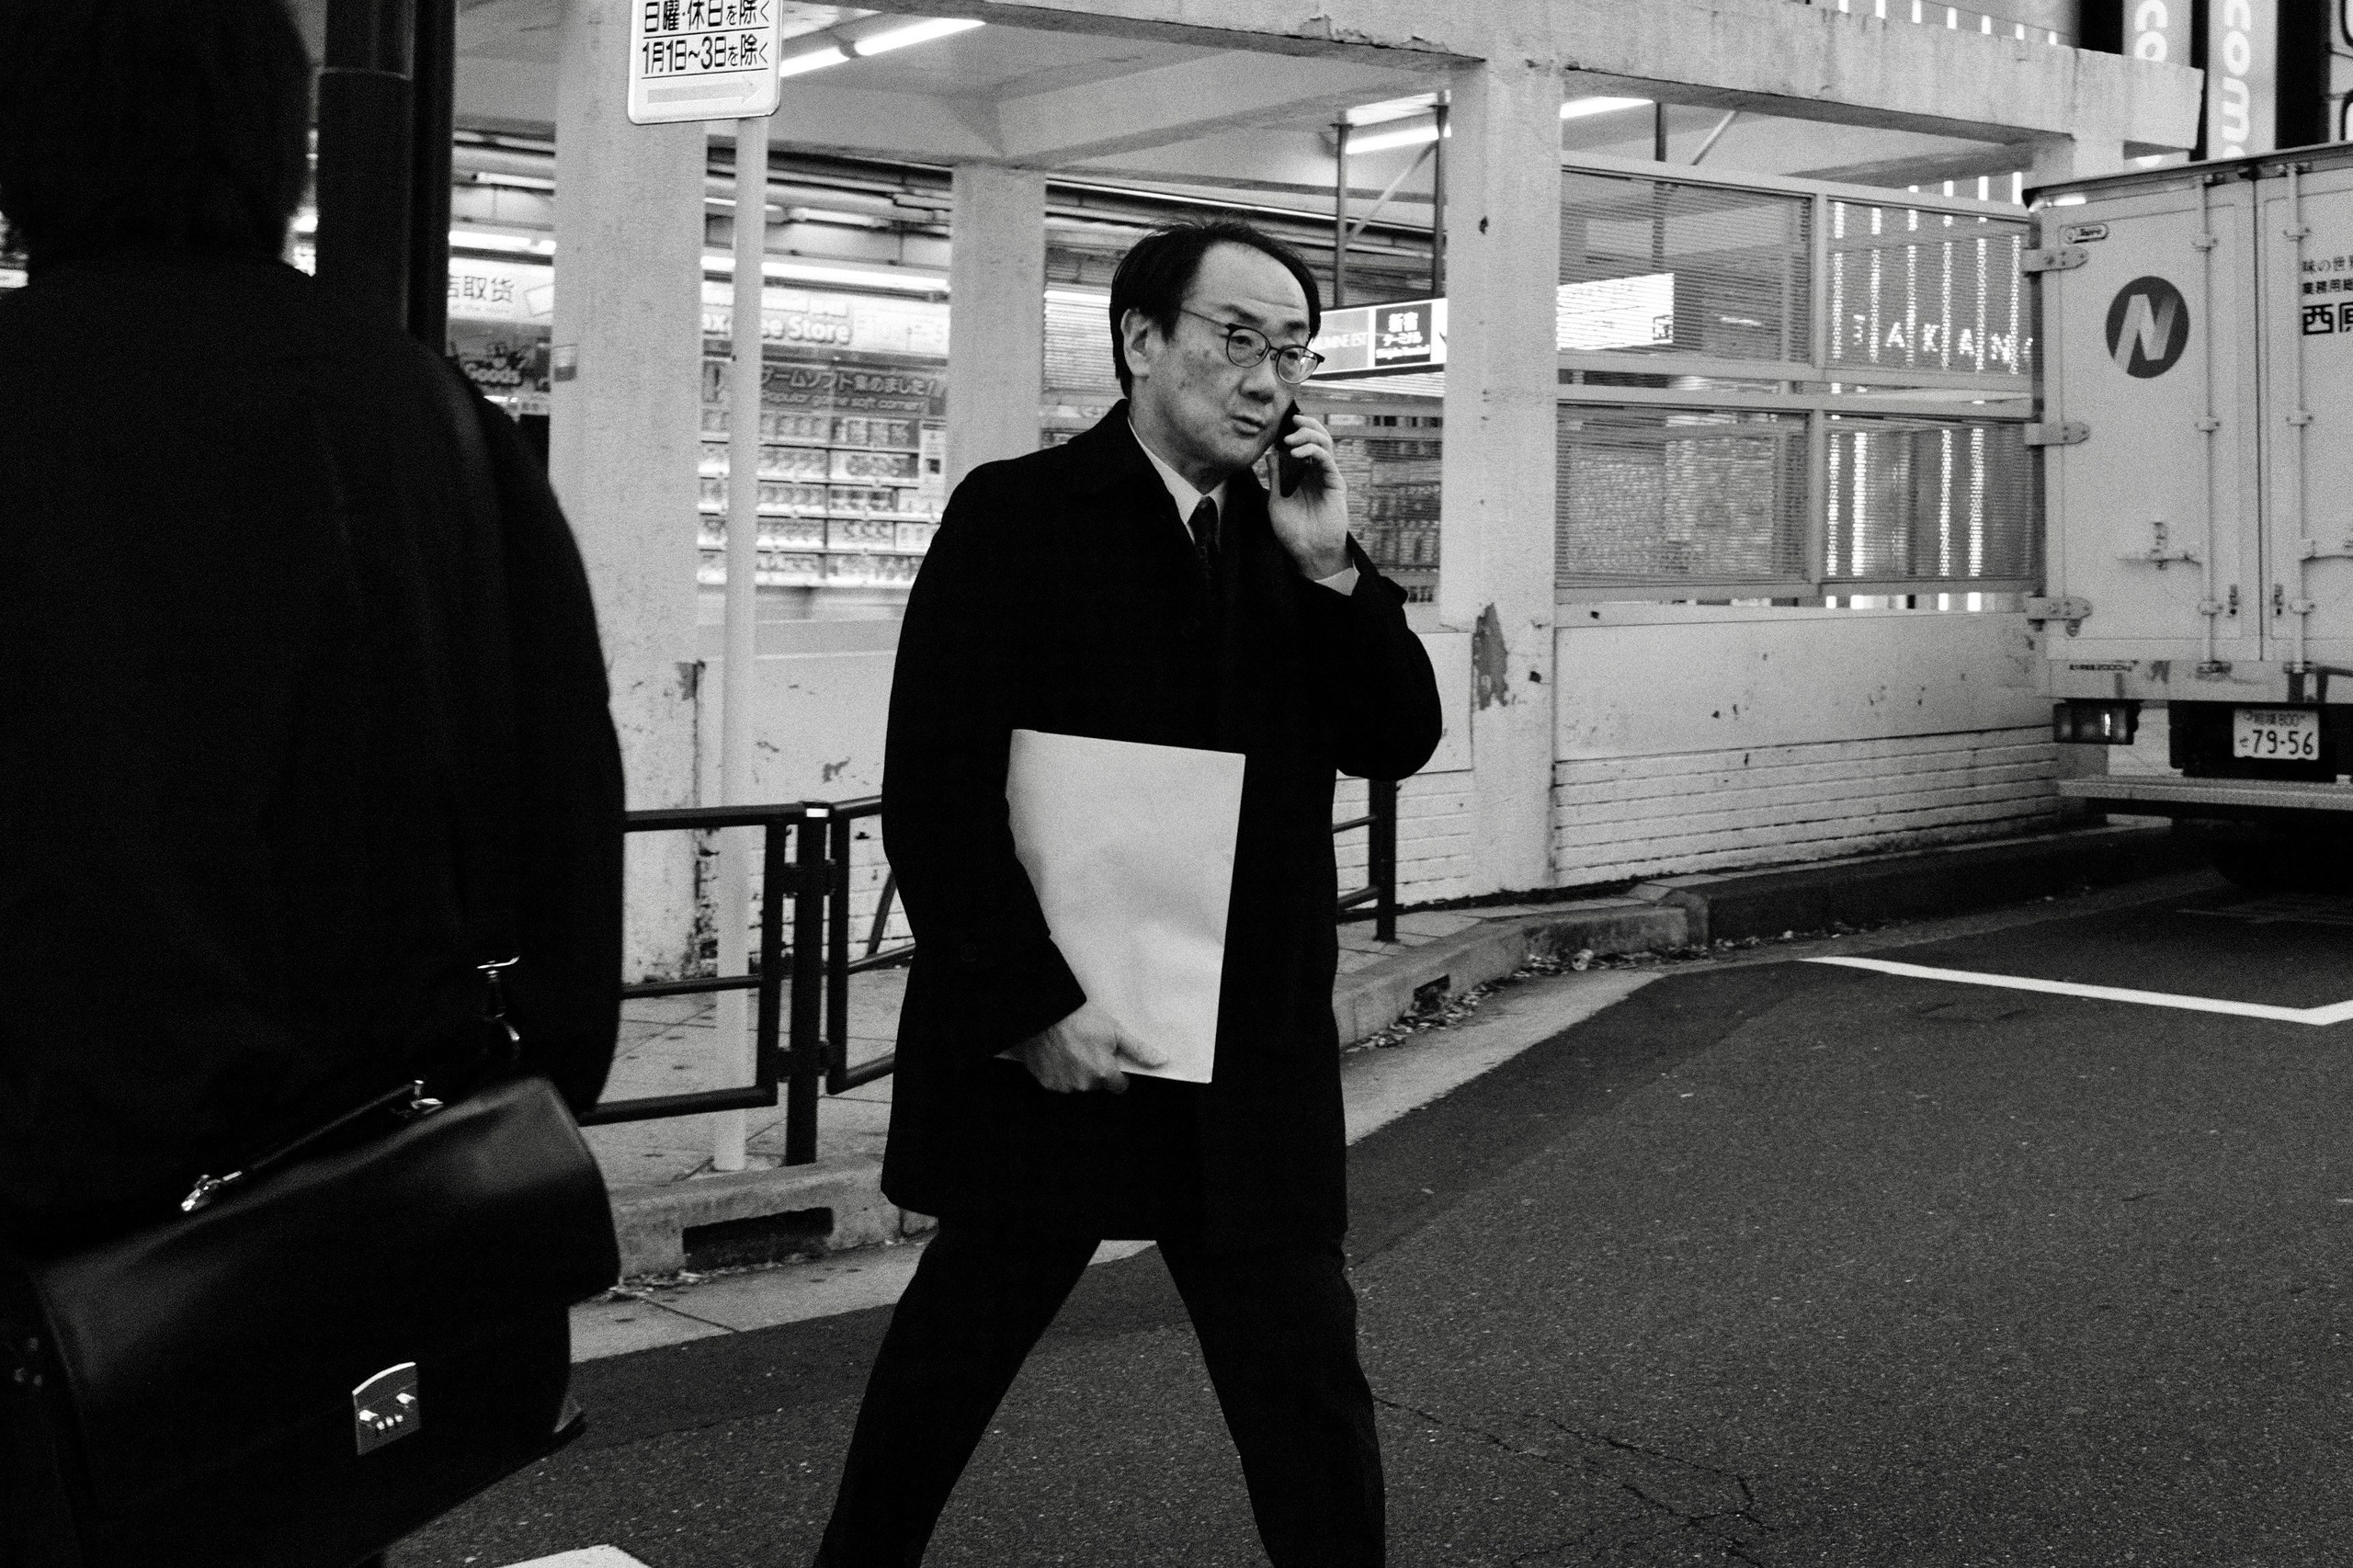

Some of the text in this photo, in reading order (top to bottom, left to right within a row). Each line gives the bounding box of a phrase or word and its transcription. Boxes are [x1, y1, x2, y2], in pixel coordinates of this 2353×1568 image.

[2222, 0, 2251, 158] com
[788, 316, 851, 345] Store
[2252, 730, 2313, 756] 79-56
